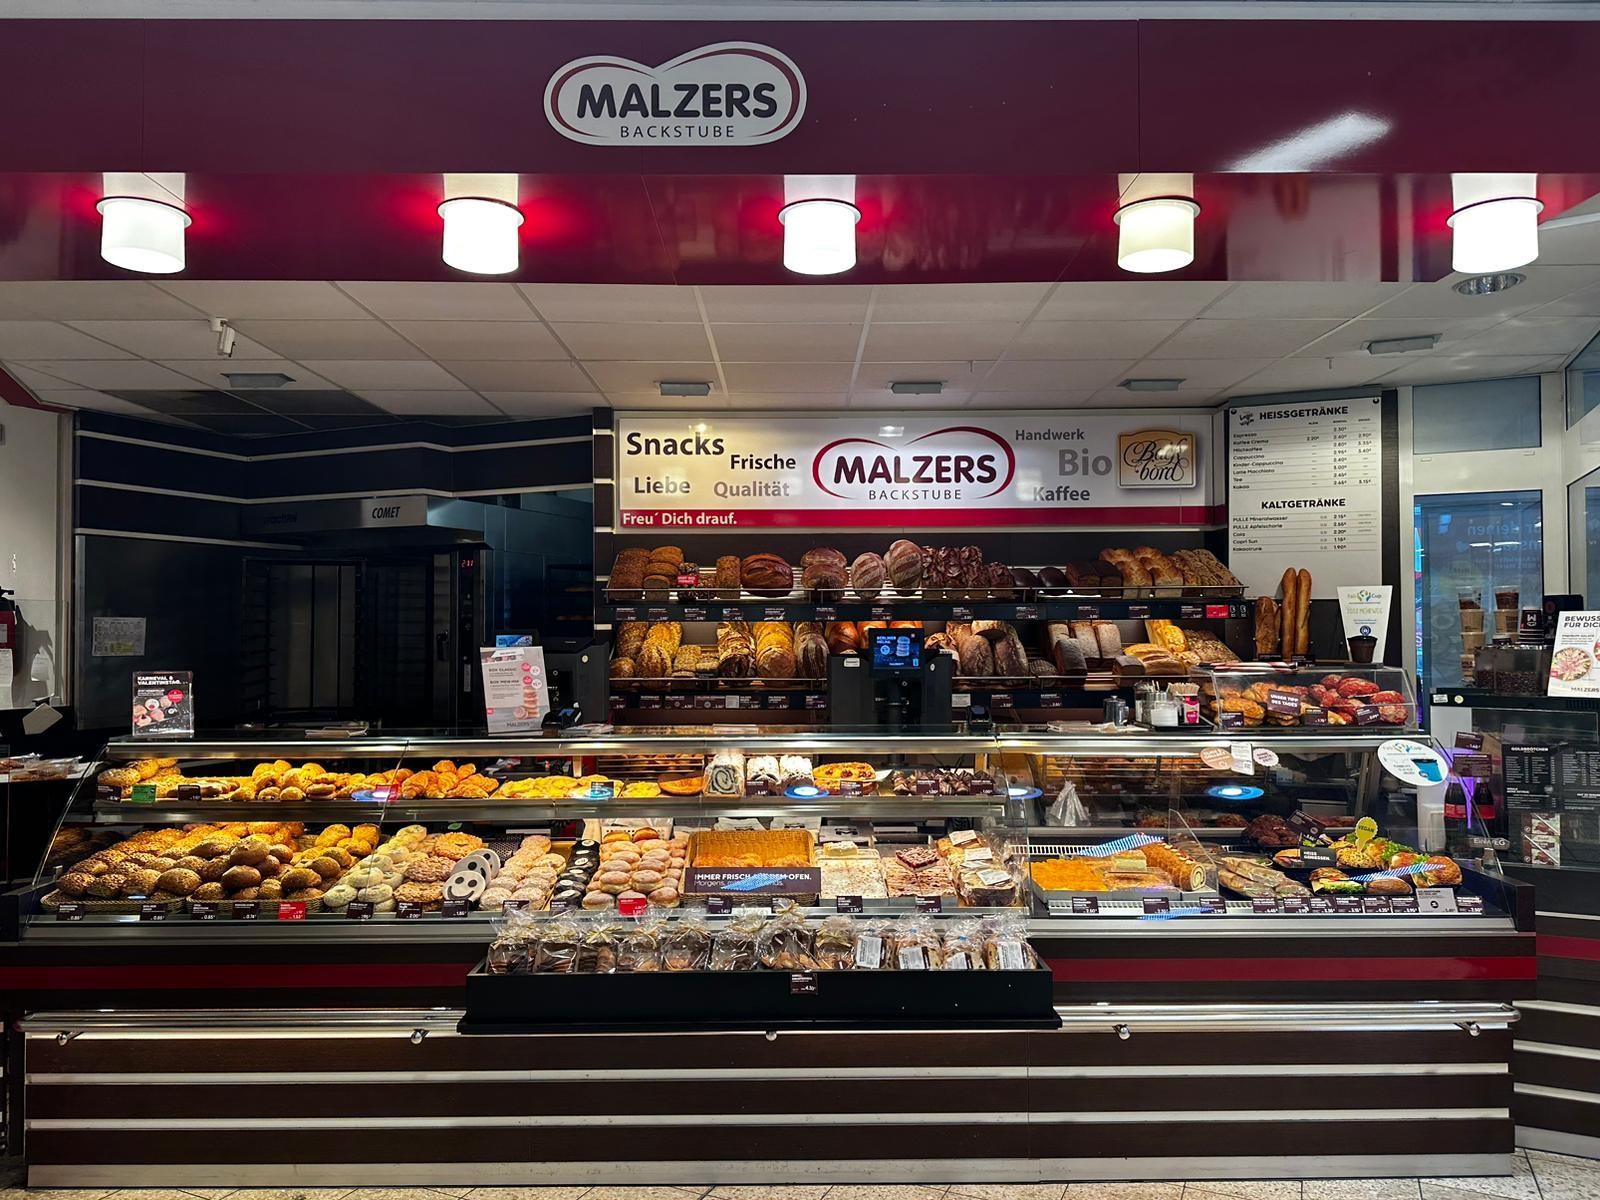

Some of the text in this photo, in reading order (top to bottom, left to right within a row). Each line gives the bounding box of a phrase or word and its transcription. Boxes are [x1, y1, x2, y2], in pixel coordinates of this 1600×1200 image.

[577, 82, 778, 119] MALZERS
[620, 125, 735, 138] BACKSTUBE
[1259, 406, 1349, 420] HEISSGETRÄNKE
[1015, 428, 1085, 441] Handwerk
[626, 431, 724, 456] Snacks
[730, 453, 796, 470] Frische
[834, 454, 997, 484] MALZERS
[1058, 448, 1113, 476] Bio
[634, 475, 691, 494] Liebe
[713, 480, 790, 499] Qualität
[869, 489, 962, 500] BACKSTUBE
[1033, 485, 1090, 501] Kaffee
[1261, 498, 1346, 509] KALTGETRÄNKE
[371, 506, 401, 519] COMET
[661, 512, 693, 525] Dich
[696, 512, 737, 525] drauf.
[1358, 825, 1375, 833] VEGAN
